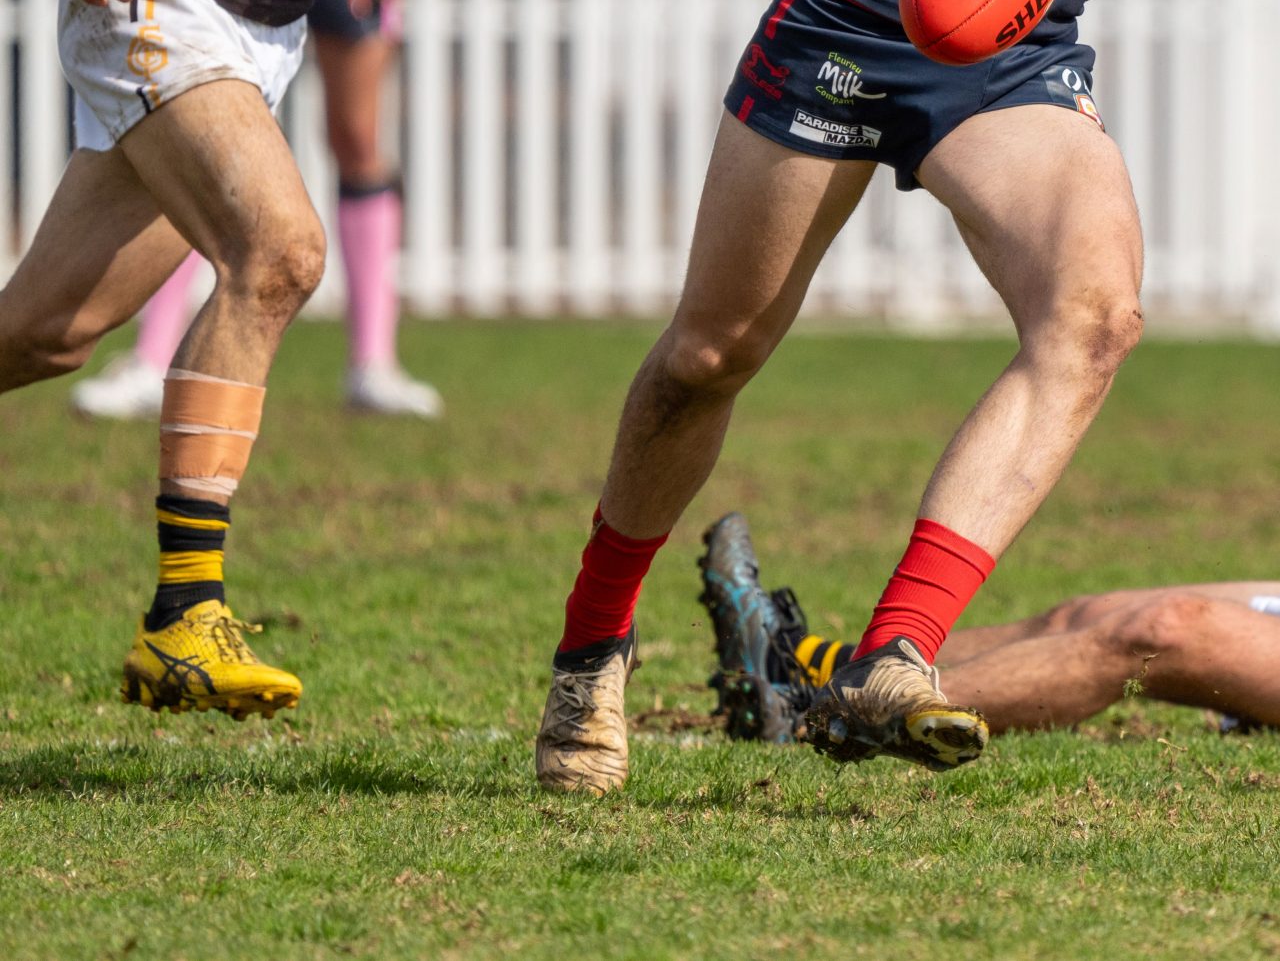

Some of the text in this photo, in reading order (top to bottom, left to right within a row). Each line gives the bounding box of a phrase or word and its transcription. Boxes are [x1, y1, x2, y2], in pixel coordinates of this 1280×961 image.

[828, 51, 863, 74] Fleurieu
[816, 60, 888, 99] Milk
[796, 111, 859, 135] PARADISE
[826, 133, 874, 146] MAZDA
